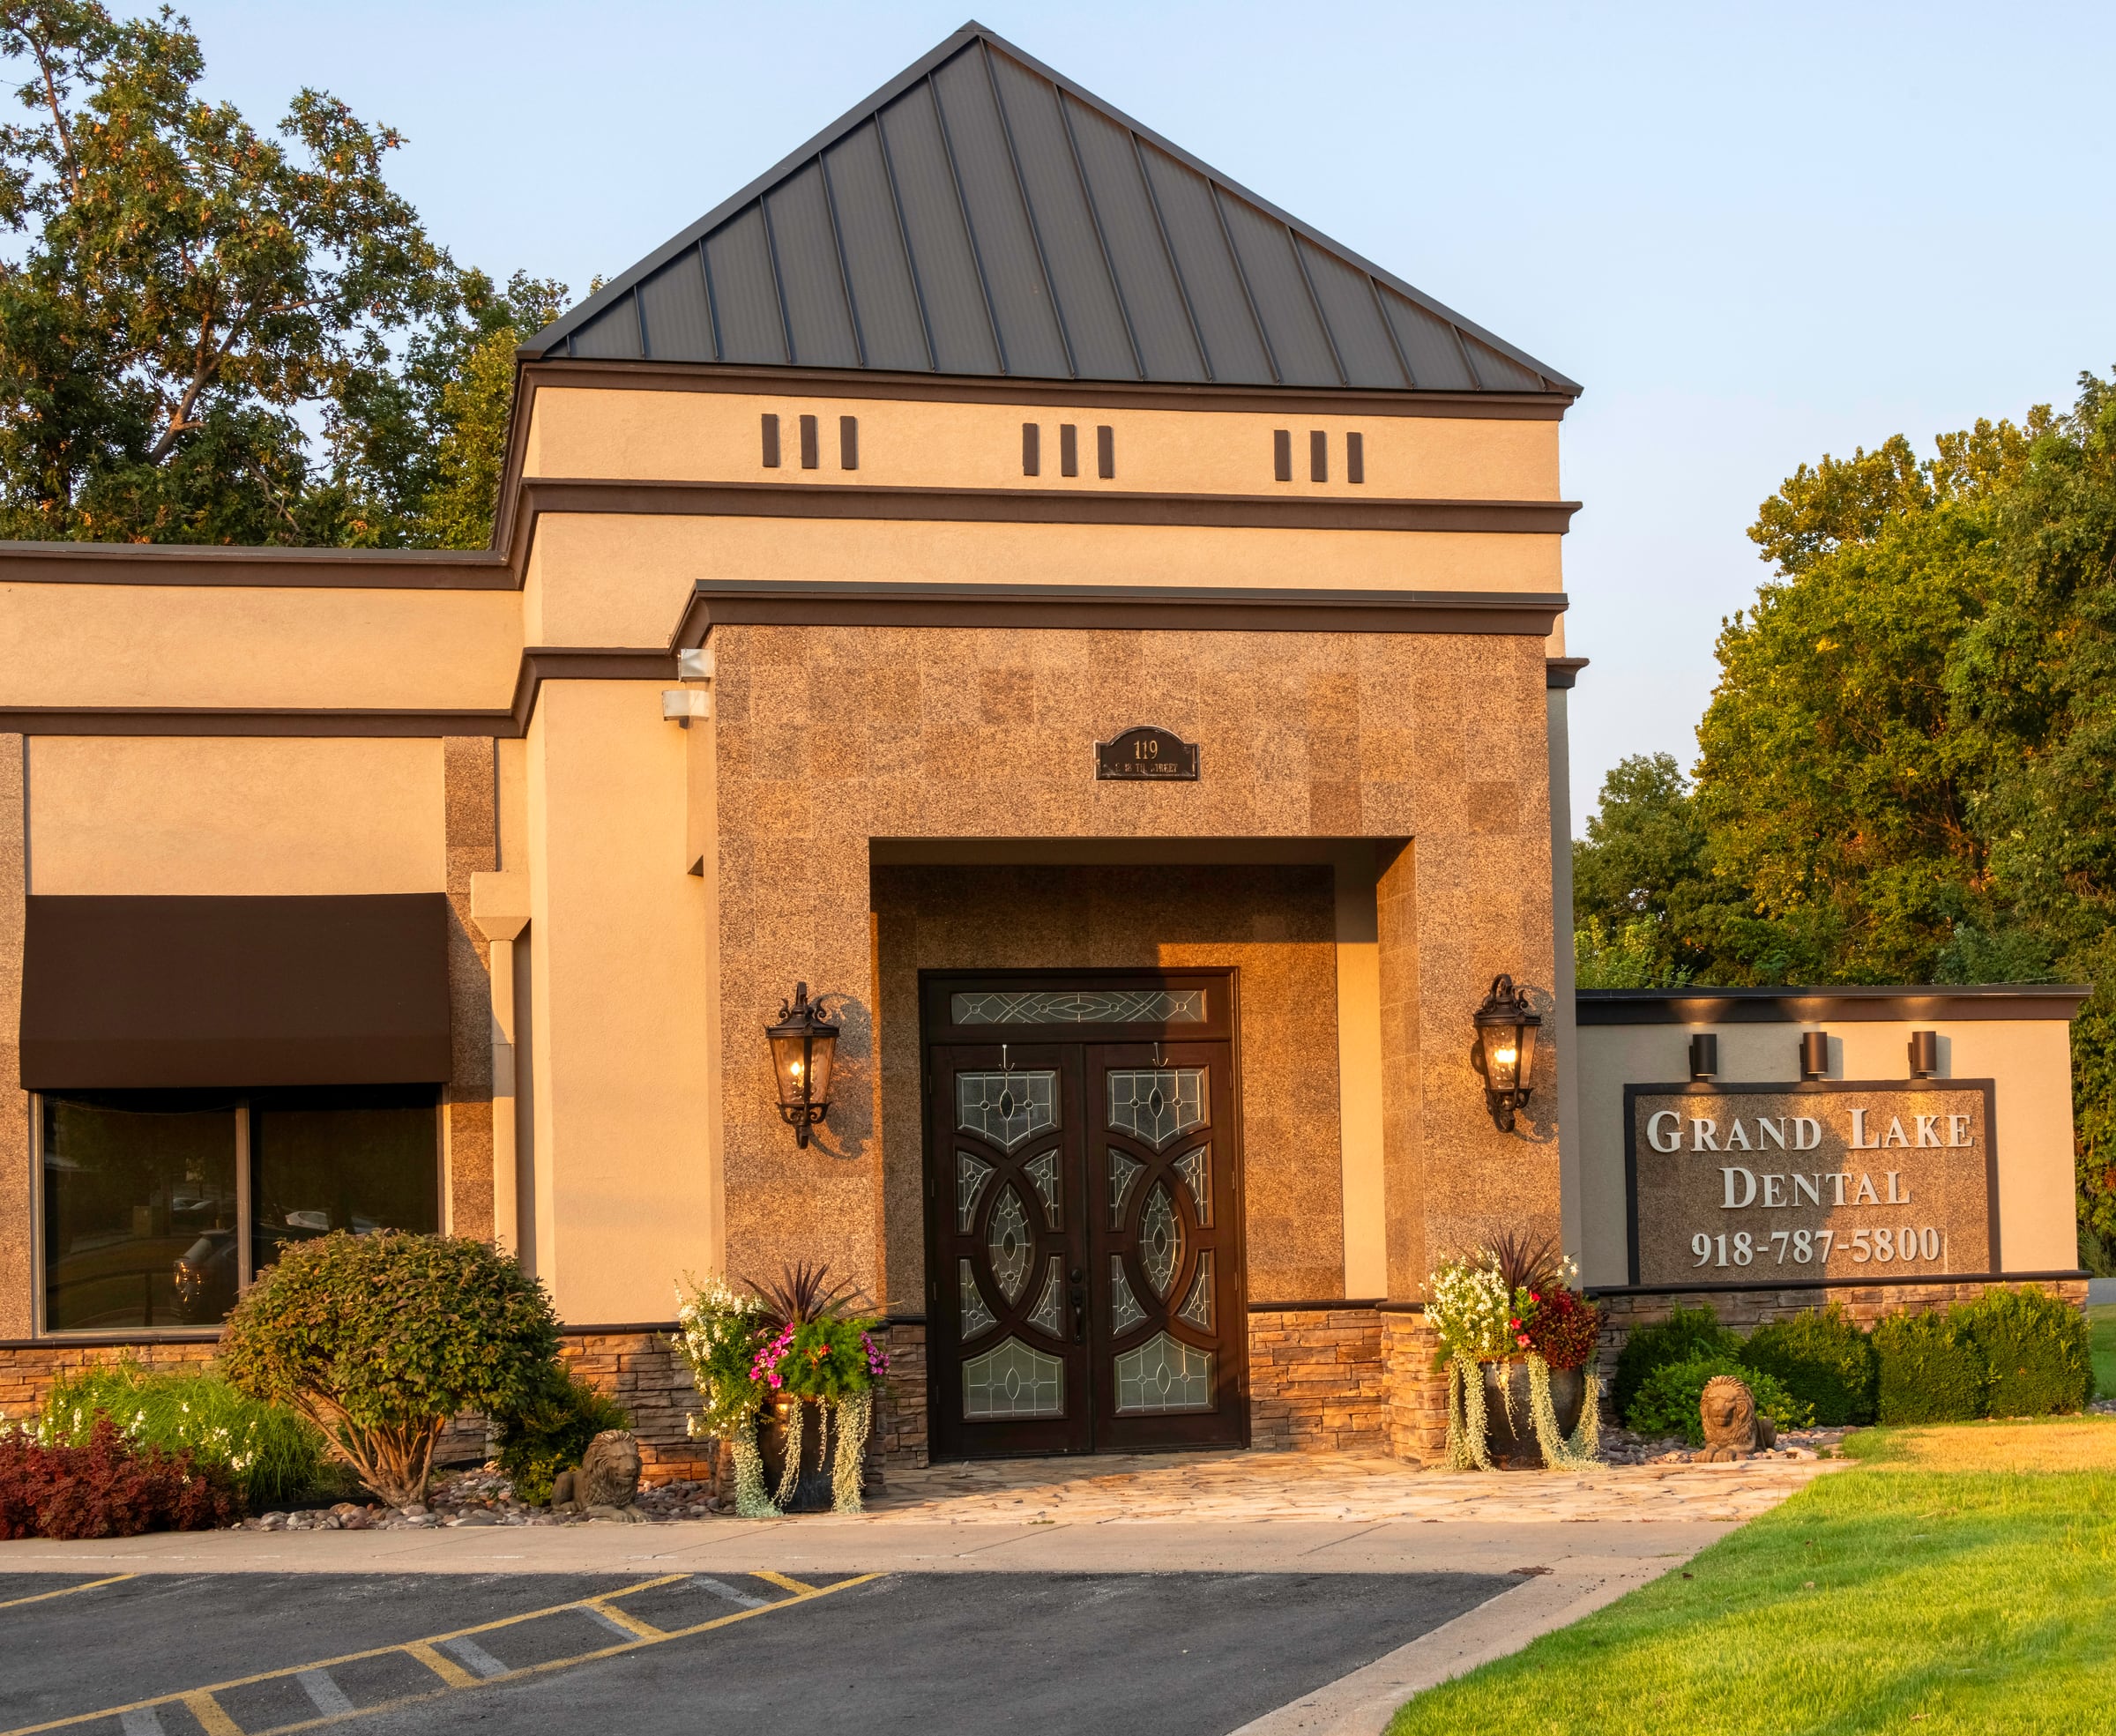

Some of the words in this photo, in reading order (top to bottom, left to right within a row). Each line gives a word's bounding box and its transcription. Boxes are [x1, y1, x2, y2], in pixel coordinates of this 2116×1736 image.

[1134, 741, 1159, 760] 119
[1151, 764, 1179, 773] STREET
[1646, 1110, 1822, 1153] GRAND
[1846, 1108, 1975, 1150] LAKE
[1718, 1166, 1911, 1210] DENTAL
[1691, 1226, 1941, 1269] 918-787-5800
